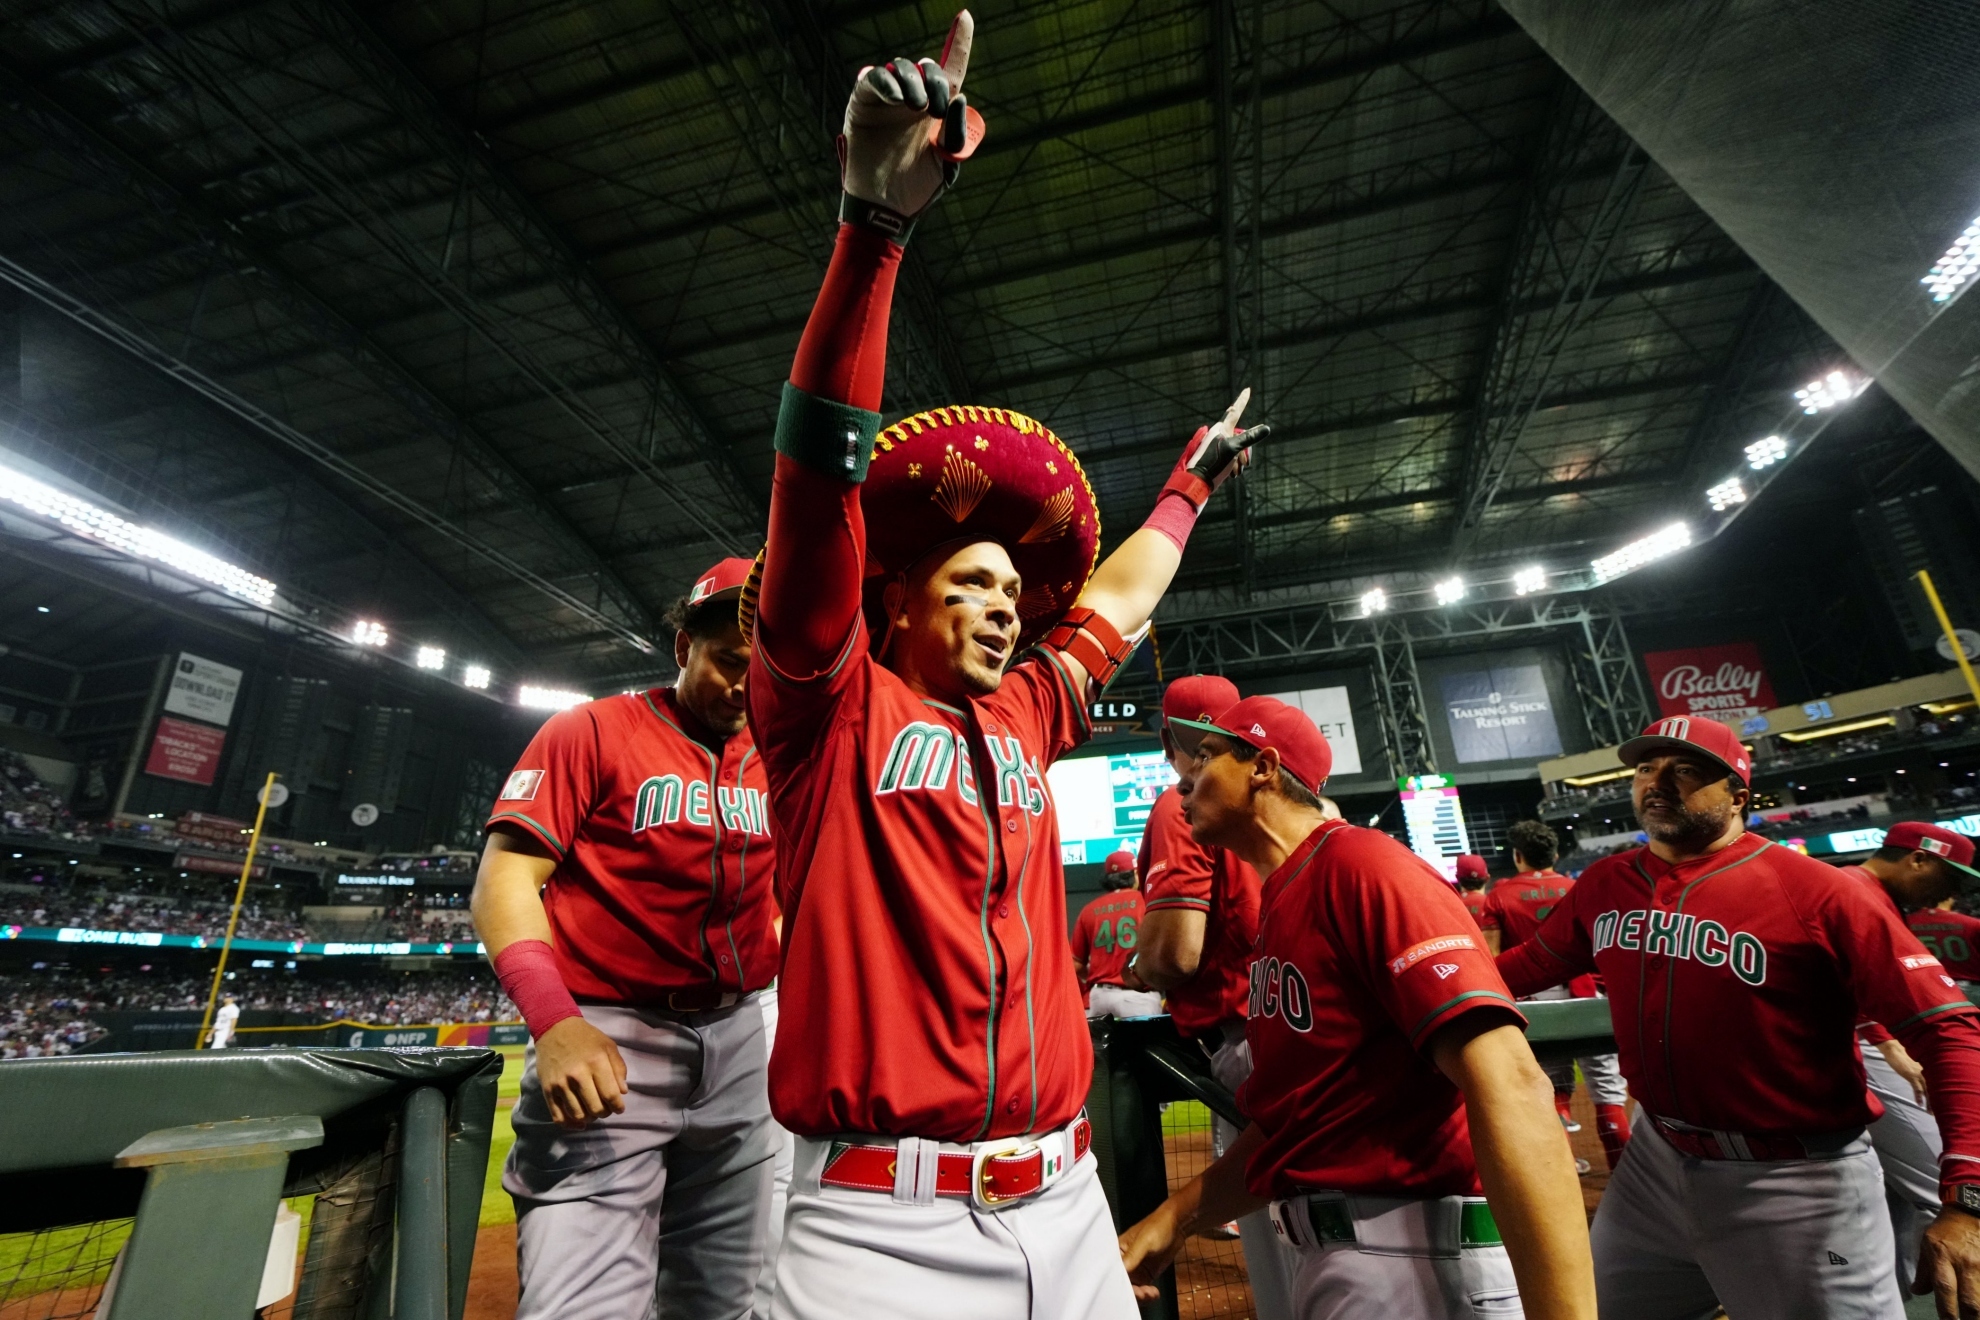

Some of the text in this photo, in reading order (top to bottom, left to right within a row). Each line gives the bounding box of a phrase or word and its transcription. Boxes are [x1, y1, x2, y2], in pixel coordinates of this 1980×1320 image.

[1661, 662, 1761, 699] Bally
[1093, 703, 1137, 717] ELD
[1687, 694, 1746, 711] SPORTS
[1803, 701, 1834, 721] 51
[1094, 899, 1137, 916] VARGAS
[1094, 916, 1138, 953] 46
[1593, 910, 1767, 986] MEXICO
[397, 1032, 427, 1045] NFP
